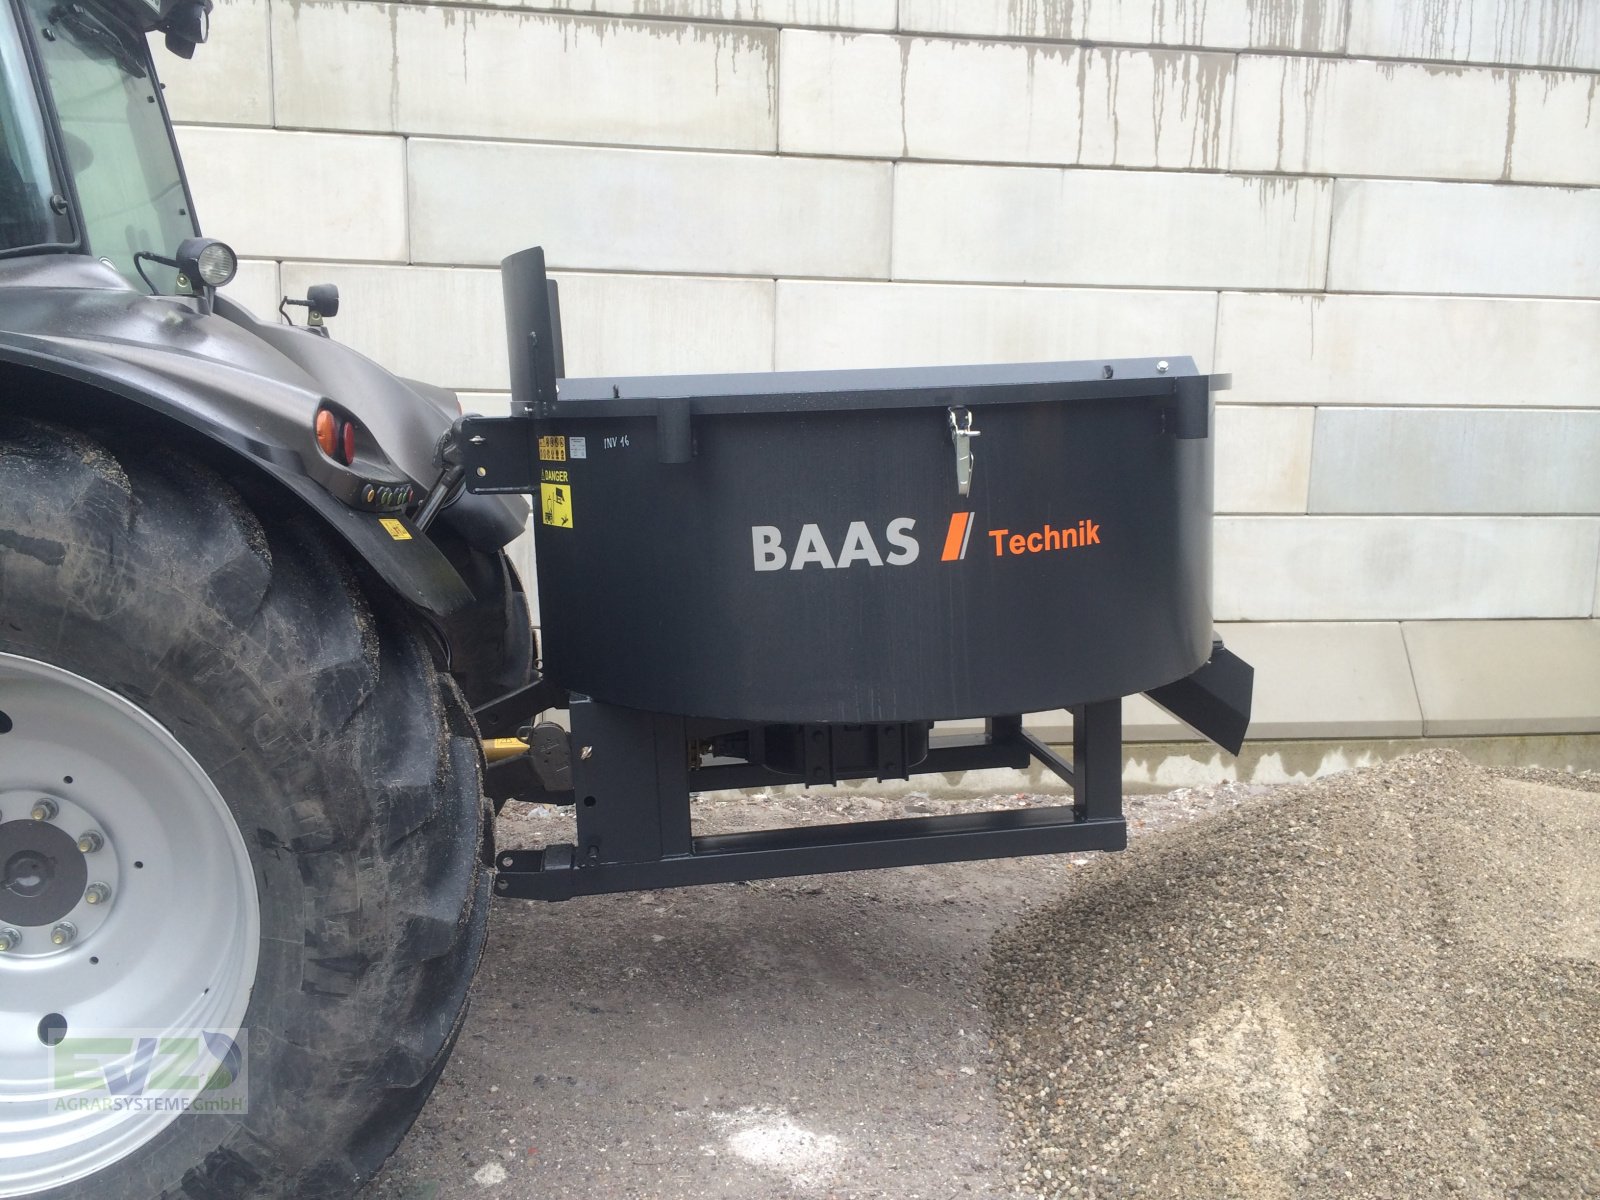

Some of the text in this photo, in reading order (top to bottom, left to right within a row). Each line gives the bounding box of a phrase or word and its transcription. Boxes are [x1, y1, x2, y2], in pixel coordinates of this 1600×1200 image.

[544, 470, 569, 481] DANGER
[751, 517, 1101, 572] BAAS Technik
